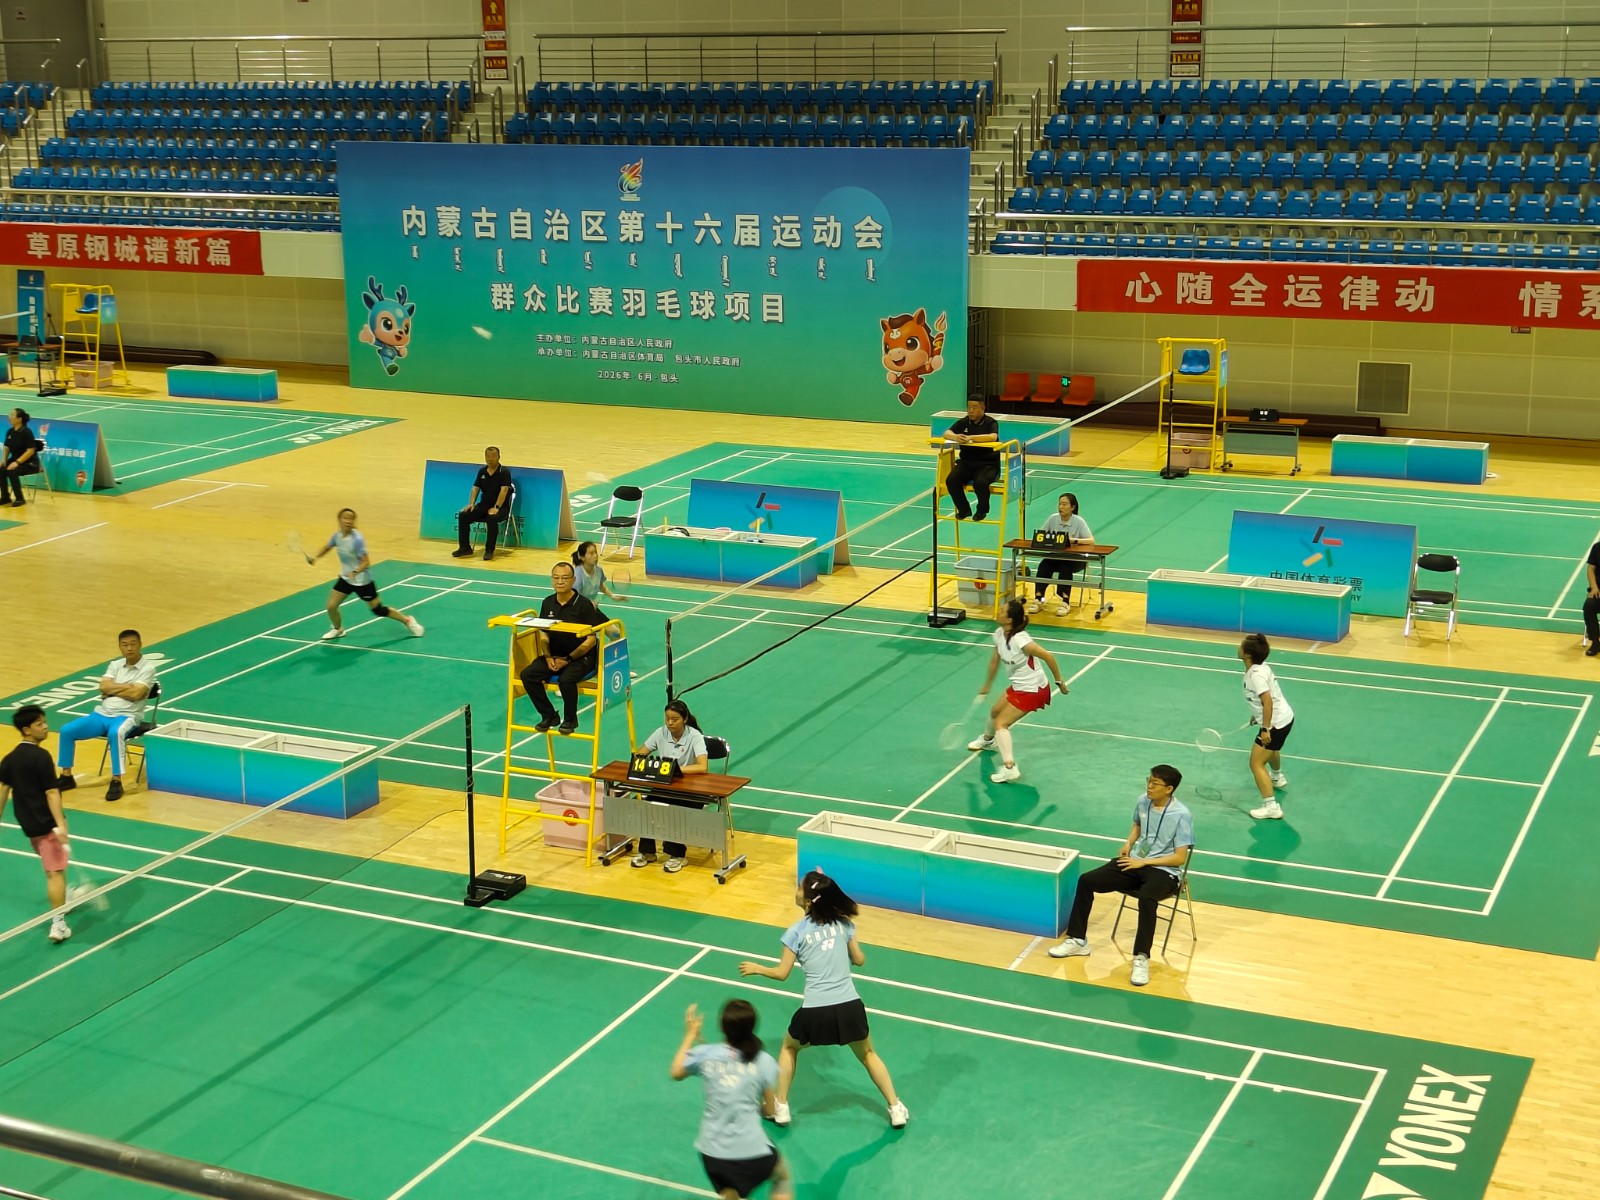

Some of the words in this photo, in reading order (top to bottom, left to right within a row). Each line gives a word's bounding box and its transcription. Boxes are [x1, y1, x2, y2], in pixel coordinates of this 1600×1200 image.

[402, 205, 884, 250] 内蒙古自治区第十六届运动会
[26, 232, 232, 266] 草原钢城谱新篇
[491, 282, 785, 323] 群众比赛羽毛球项目
[1125, 271, 1435, 313] 心随全运律动
[674, 354, 740, 367] 包头市人民政府
[1036, 533, 1044, 543] 6
[1056, 534, 1065, 544] 10
[1270, 569, 1363, 592] 中国体育彩票
[634, 758, 646, 772] 14
[653, 760, 660, 769] 0
[660, 761, 671, 775] 8
[1378, 1063, 1492, 1171] YONEX
